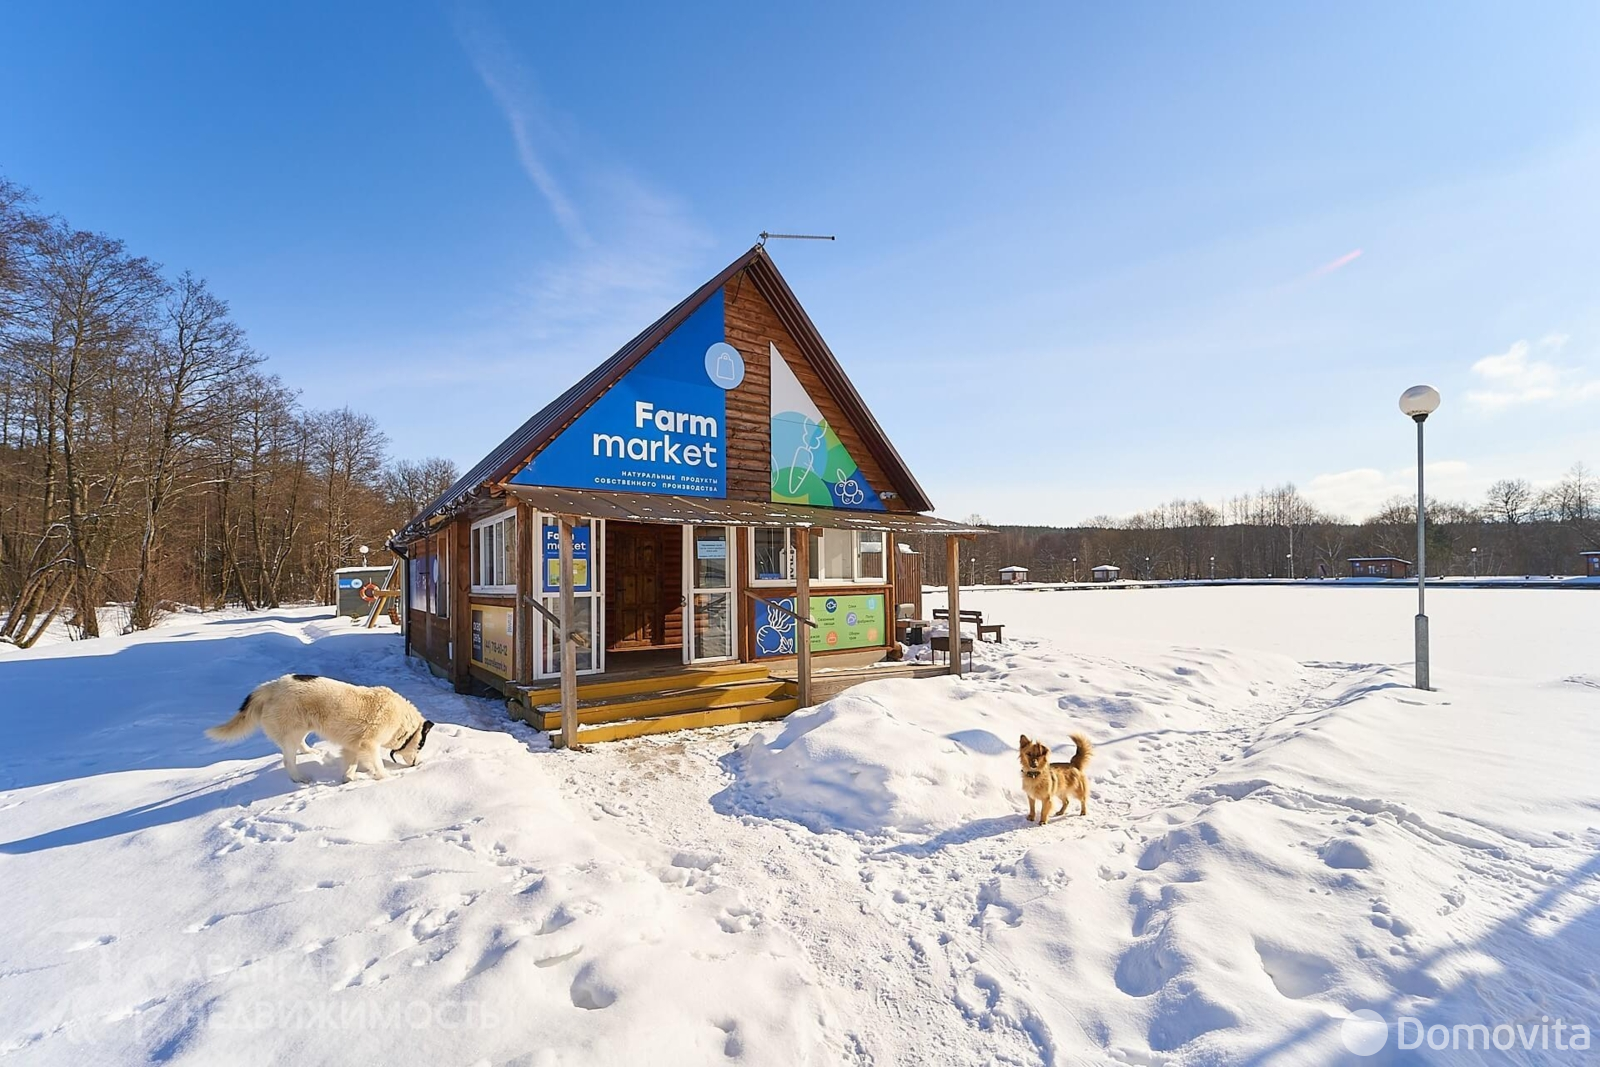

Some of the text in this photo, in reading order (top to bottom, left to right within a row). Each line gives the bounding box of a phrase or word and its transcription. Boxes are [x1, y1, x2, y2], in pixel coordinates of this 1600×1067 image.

[635, 401, 718, 438] Farm
[592, 433, 718, 469] market
[621, 470, 718, 484] НАТУРАЛЬНЫЕ ПРОДУКТЫ
[594, 477, 718, 492] СОБСТВЕННОГО ПРОИЗВОДСТВА
[547, 531, 575, 540] Fa
[547, 541, 587, 551] met
